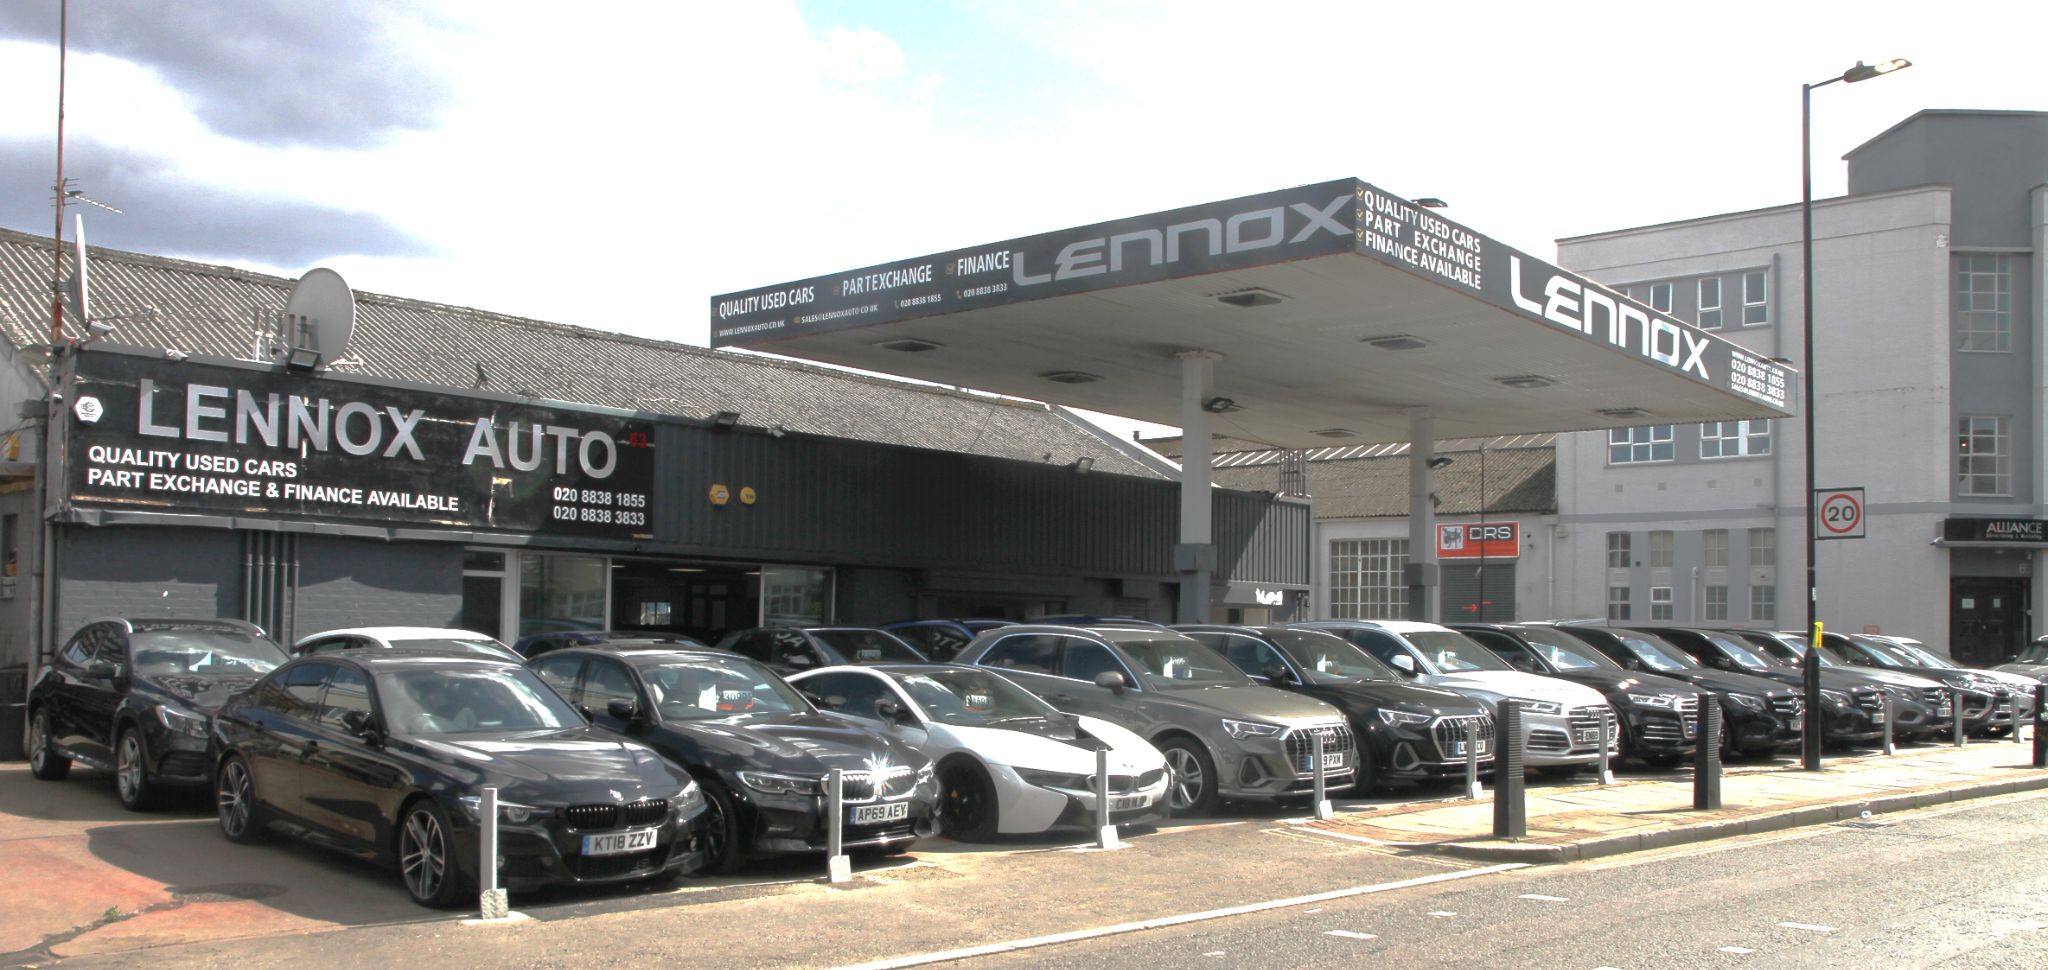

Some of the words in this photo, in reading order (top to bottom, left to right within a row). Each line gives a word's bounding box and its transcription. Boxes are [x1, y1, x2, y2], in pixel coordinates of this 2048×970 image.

[1364, 190, 1418, 225] QUALITY
[1420, 213, 1449, 239] USED
[1452, 228, 1481, 253] CARS
[1013, 194, 1354, 286] LENNOX
[1365, 210, 1400, 238] PART
[1414, 230, 1481, 271] EXCHANGE
[957, 250, 1010, 277] FINANCE
[1365, 230, 1418, 265] FINANCE
[1420, 253, 1481, 290] AVAILABLE
[719, 293, 760, 320] QUALITY
[762, 290, 786, 310] USED
[789, 286, 815, 306] CARS
[901, 298, 911, 308] 020
[927, 293, 942, 303] 1855
[963, 288, 975, 297] 020
[976, 286, 991, 295] 8838
[992, 283, 1008, 293] 3833
[1510, 255, 1710, 380] LENNOX
[1731, 359, 1746, 373] 020
[1747, 365, 1766, 380] 8838
[1768, 373, 1785, 388] 1855
[1731, 372, 1746, 385] 020
[1747, 377, 1766, 392] 8838
[1767, 385, 1785, 399] 3833
[139, 378, 426, 460] LENNOX
[462, 417, 618, 479] AUTO
[89, 445, 180, 469] QUALITY
[186, 454, 239, 474] USED
[244, 459, 297, 478] CARS
[88, 469, 144, 488] PART
[149, 472, 260, 496] EXCHANGE
[266, 482, 279, 498] &
[284, 484, 362, 505] FINANCE
[367, 490, 459, 512] AVAILABLE
[554, 487, 577, 502] 020
[581, 489, 612, 505] 8838
[616, 493, 646, 508] 1855
[553, 506, 577, 521] 020
[581, 508, 612, 523] 8838
[615, 510, 645, 526] 3833
[1828, 505, 1855, 521] 20
[1469, 526, 1511, 540] DRS
[1986, 521, 2043, 534] ALLIANCE
[858, 806, 885, 821] AP69
[887, 803, 906, 818] AEY
[595, 834, 626, 851] KT18
[628, 831, 653, 848] ZZV
